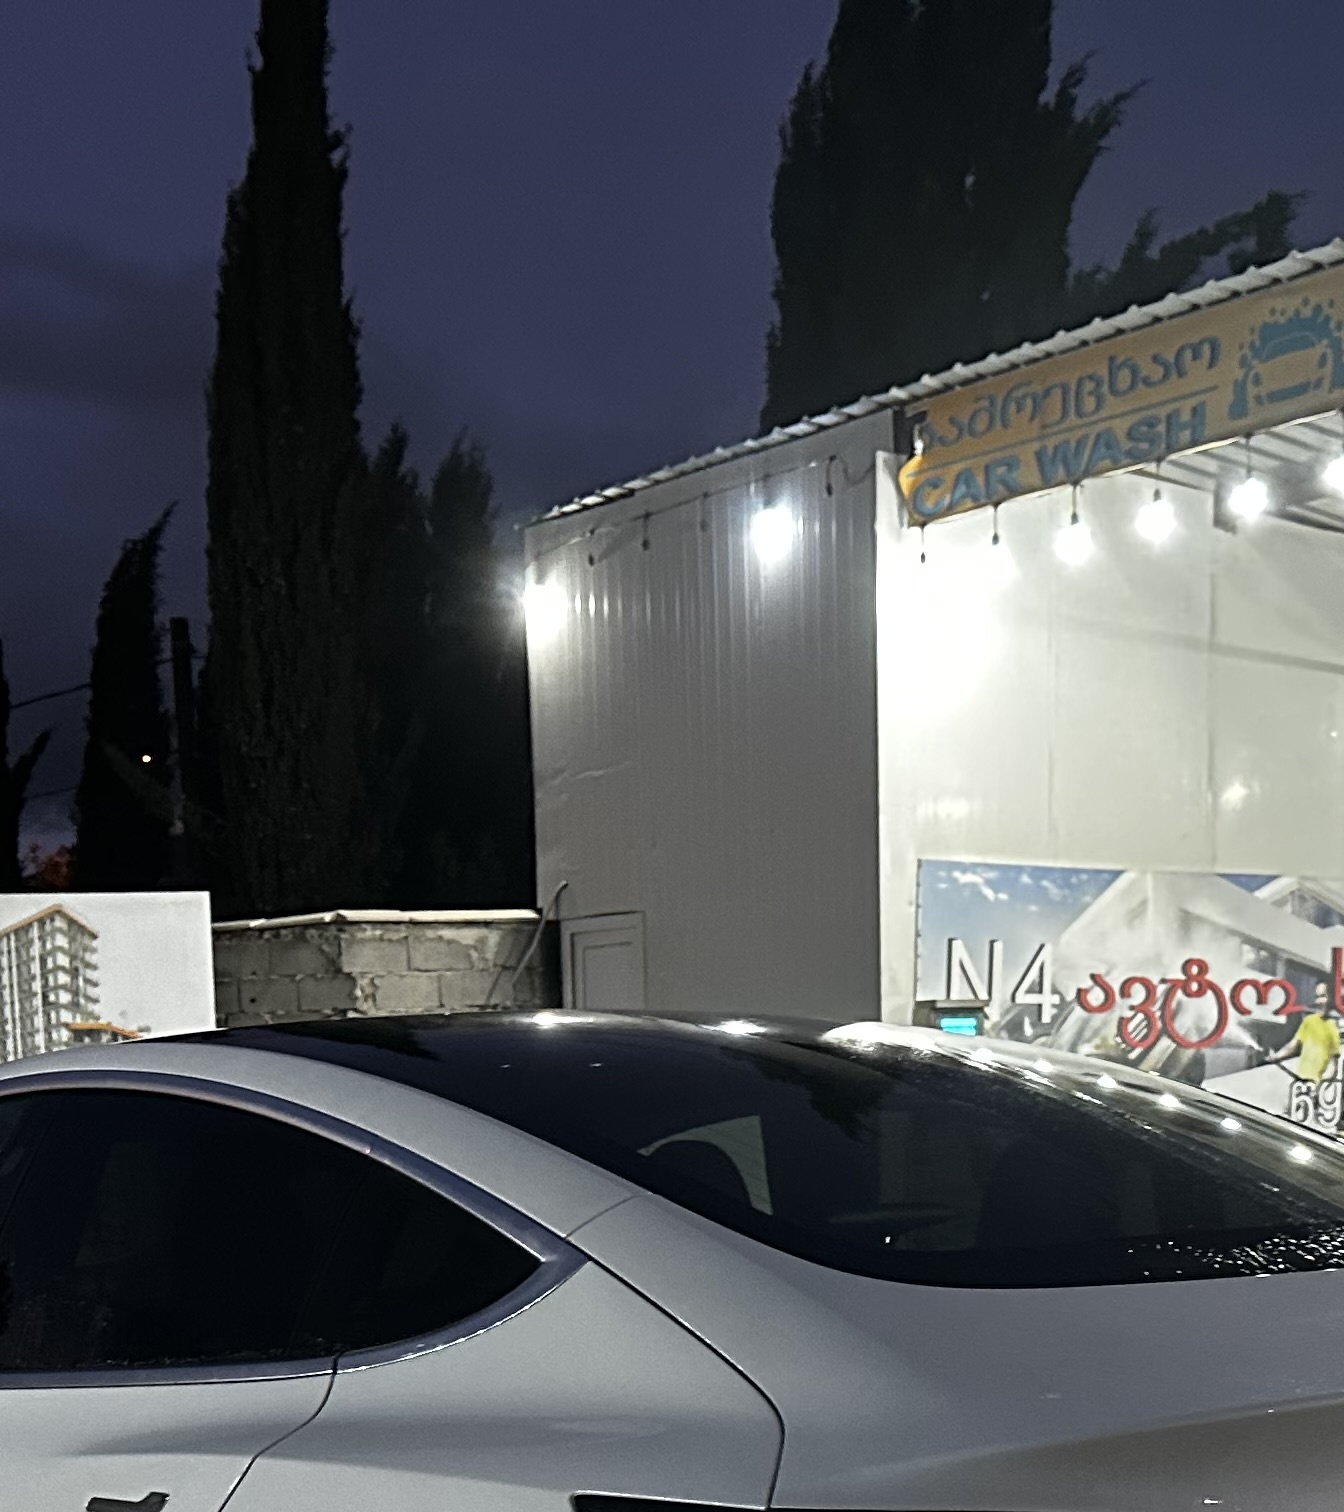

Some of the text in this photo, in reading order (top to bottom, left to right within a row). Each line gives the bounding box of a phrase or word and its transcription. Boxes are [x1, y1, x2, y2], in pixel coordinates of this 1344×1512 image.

[912, 400, 1206, 518] CAR WASH
[946, 937, 1060, 1023] N4
[1076, 957, 1306, 1050] ავტო
